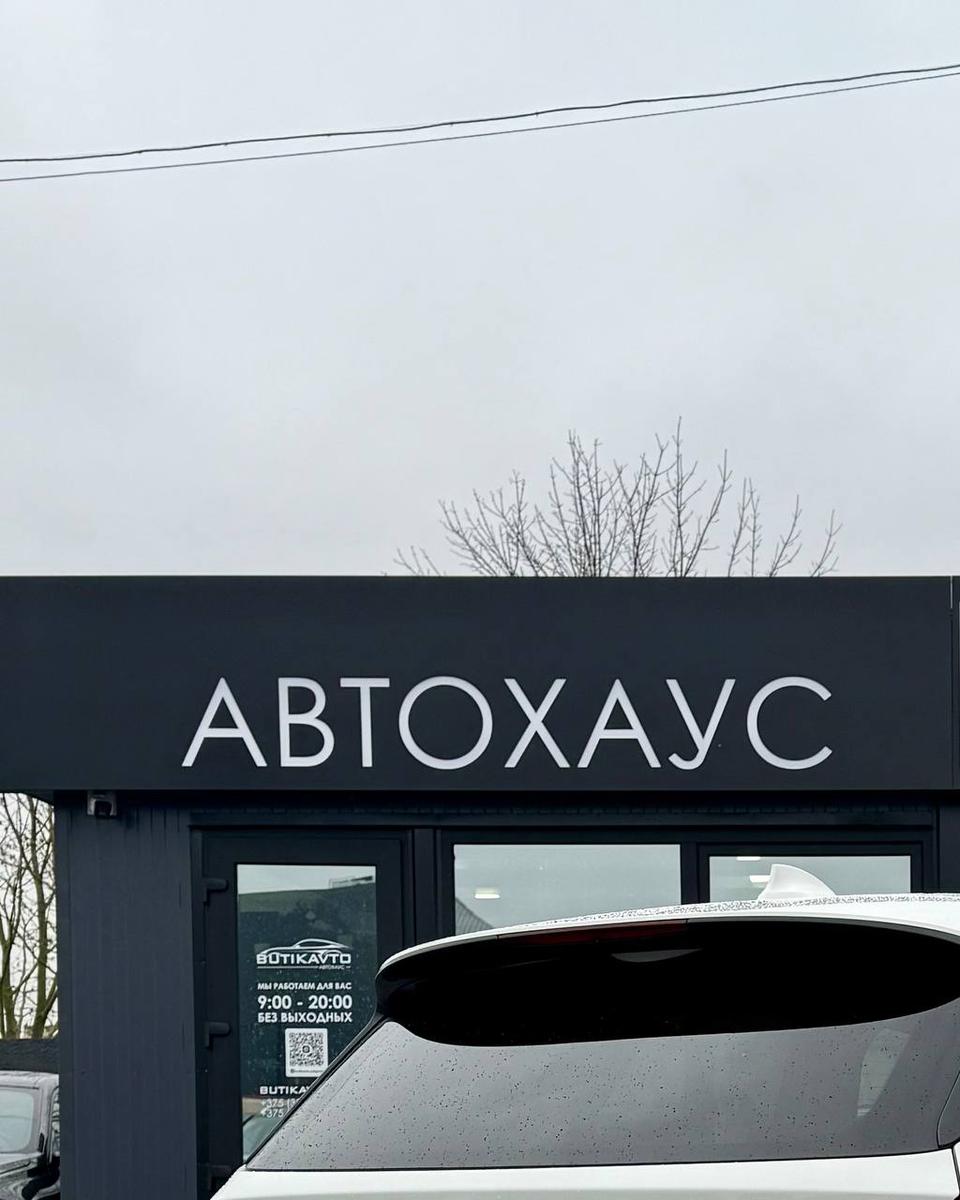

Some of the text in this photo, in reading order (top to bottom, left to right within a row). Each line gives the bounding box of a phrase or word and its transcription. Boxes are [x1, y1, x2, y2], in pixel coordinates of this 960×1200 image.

[181, 676, 832, 771] АВТОХАУС
[256, 953, 351, 965] BUTIKAVTO
[257, 982, 352, 991] МЫ РАБОТАЕМ ДЛЯ ВАС
[257, 995, 292, 1009] 9:00
[308, 995, 352, 1009] 20:00
[257, 1012, 353, 1024] БЕЗ ВЫХОДНЫХ
